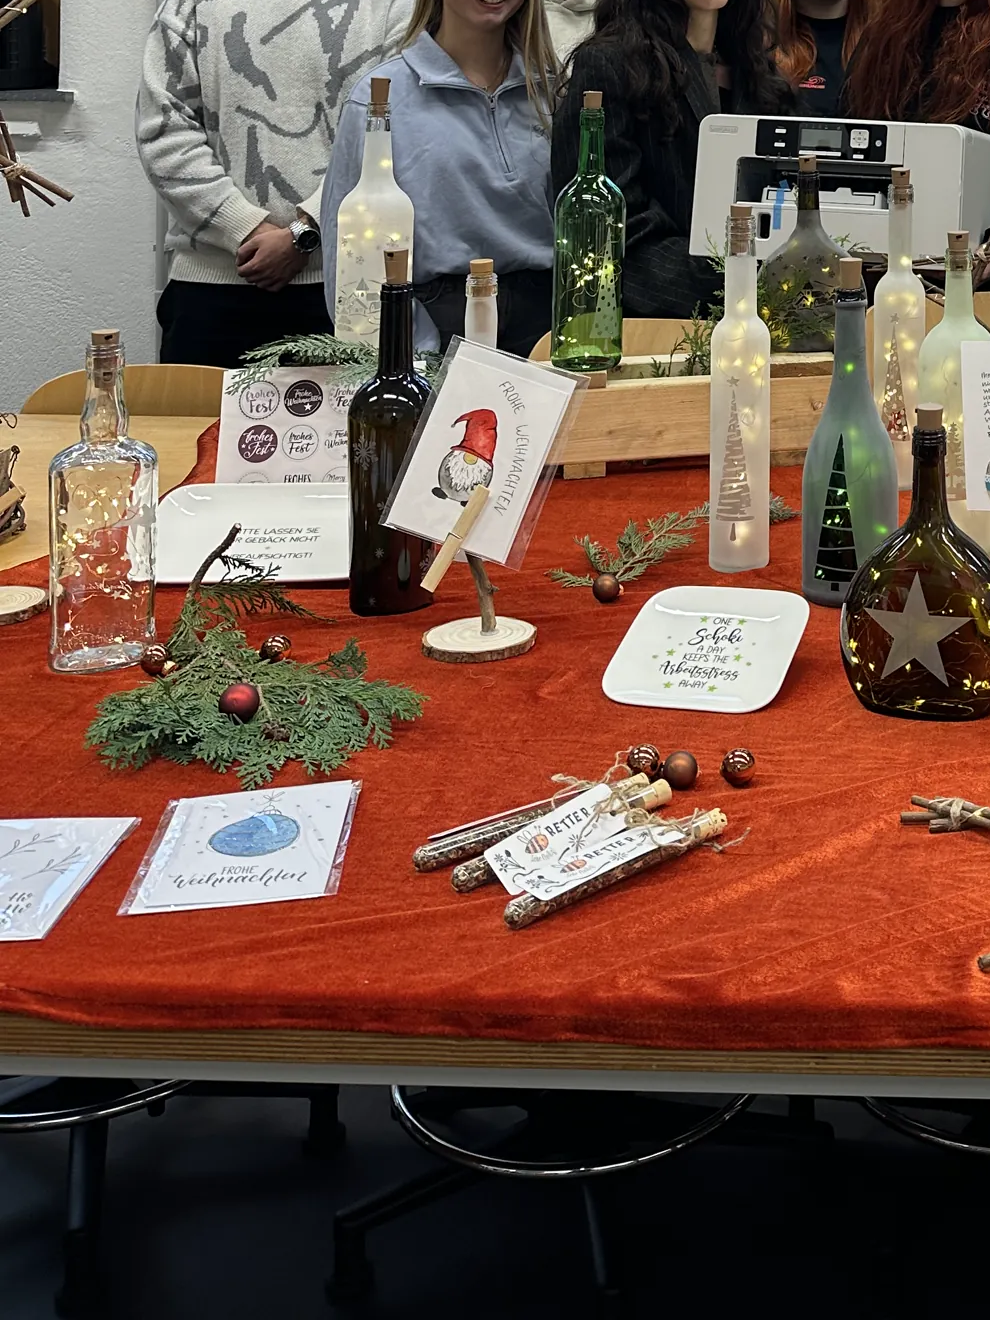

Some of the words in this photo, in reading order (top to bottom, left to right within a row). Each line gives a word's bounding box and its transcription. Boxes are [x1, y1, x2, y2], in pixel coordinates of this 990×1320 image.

[246, 389, 275, 402] frohes
[333, 387, 354, 398] frohe
[499, 380, 525, 415] FROHE
[250, 399, 275, 413] Fest
[243, 429, 274, 444] frohes
[289, 432, 313, 442] frohes
[243, 441, 276, 458] Fest
[287, 441, 315, 455] Fest
[494, 424, 530, 516] WEIHNACHTEN
[327, 474, 346, 482] Merry
[245, 535, 288, 544] GEBÄCK
[288, 535, 321, 543] NICHT
[231, 552, 313, 560] BEAUFSICHTIGT!
[713, 617, 733, 626] ONE
[688, 626, 744, 646] Schoki
[696, 645, 704, 653] A
[706, 645, 726, 654] DAY
[682, 652, 710, 662] KEEPS
[713, 655, 730, 664] THE
[659, 660, 740, 681] Arbeitsstress
[678, 680, 708, 689] AWAY
[545, 806, 591, 837] RETTER
[583, 836, 636, 860] RETTER
[221, 865, 259, 875] FROHE
[168, 867, 308, 889] Weihnachten
